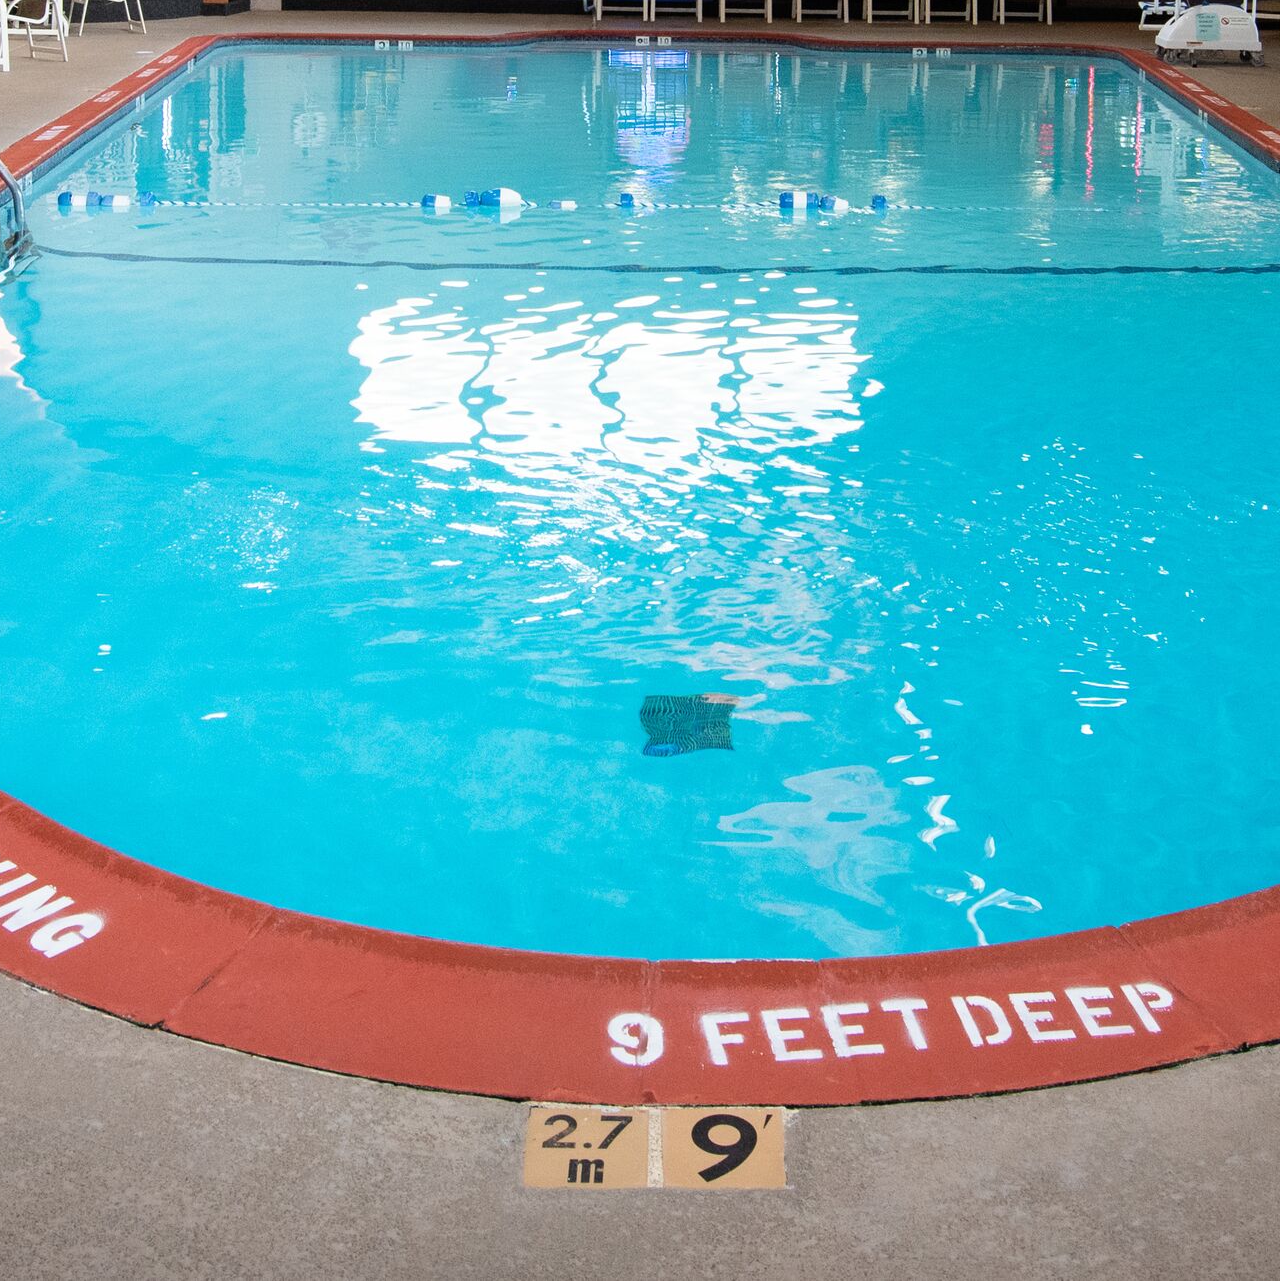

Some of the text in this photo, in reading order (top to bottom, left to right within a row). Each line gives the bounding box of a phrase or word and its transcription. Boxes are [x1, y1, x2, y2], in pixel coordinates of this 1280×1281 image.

[607, 982, 1175, 1066] 9 FEET DEEP
[542, 1113, 634, 1150] 2.7
[567, 1158, 605, 1184] m
